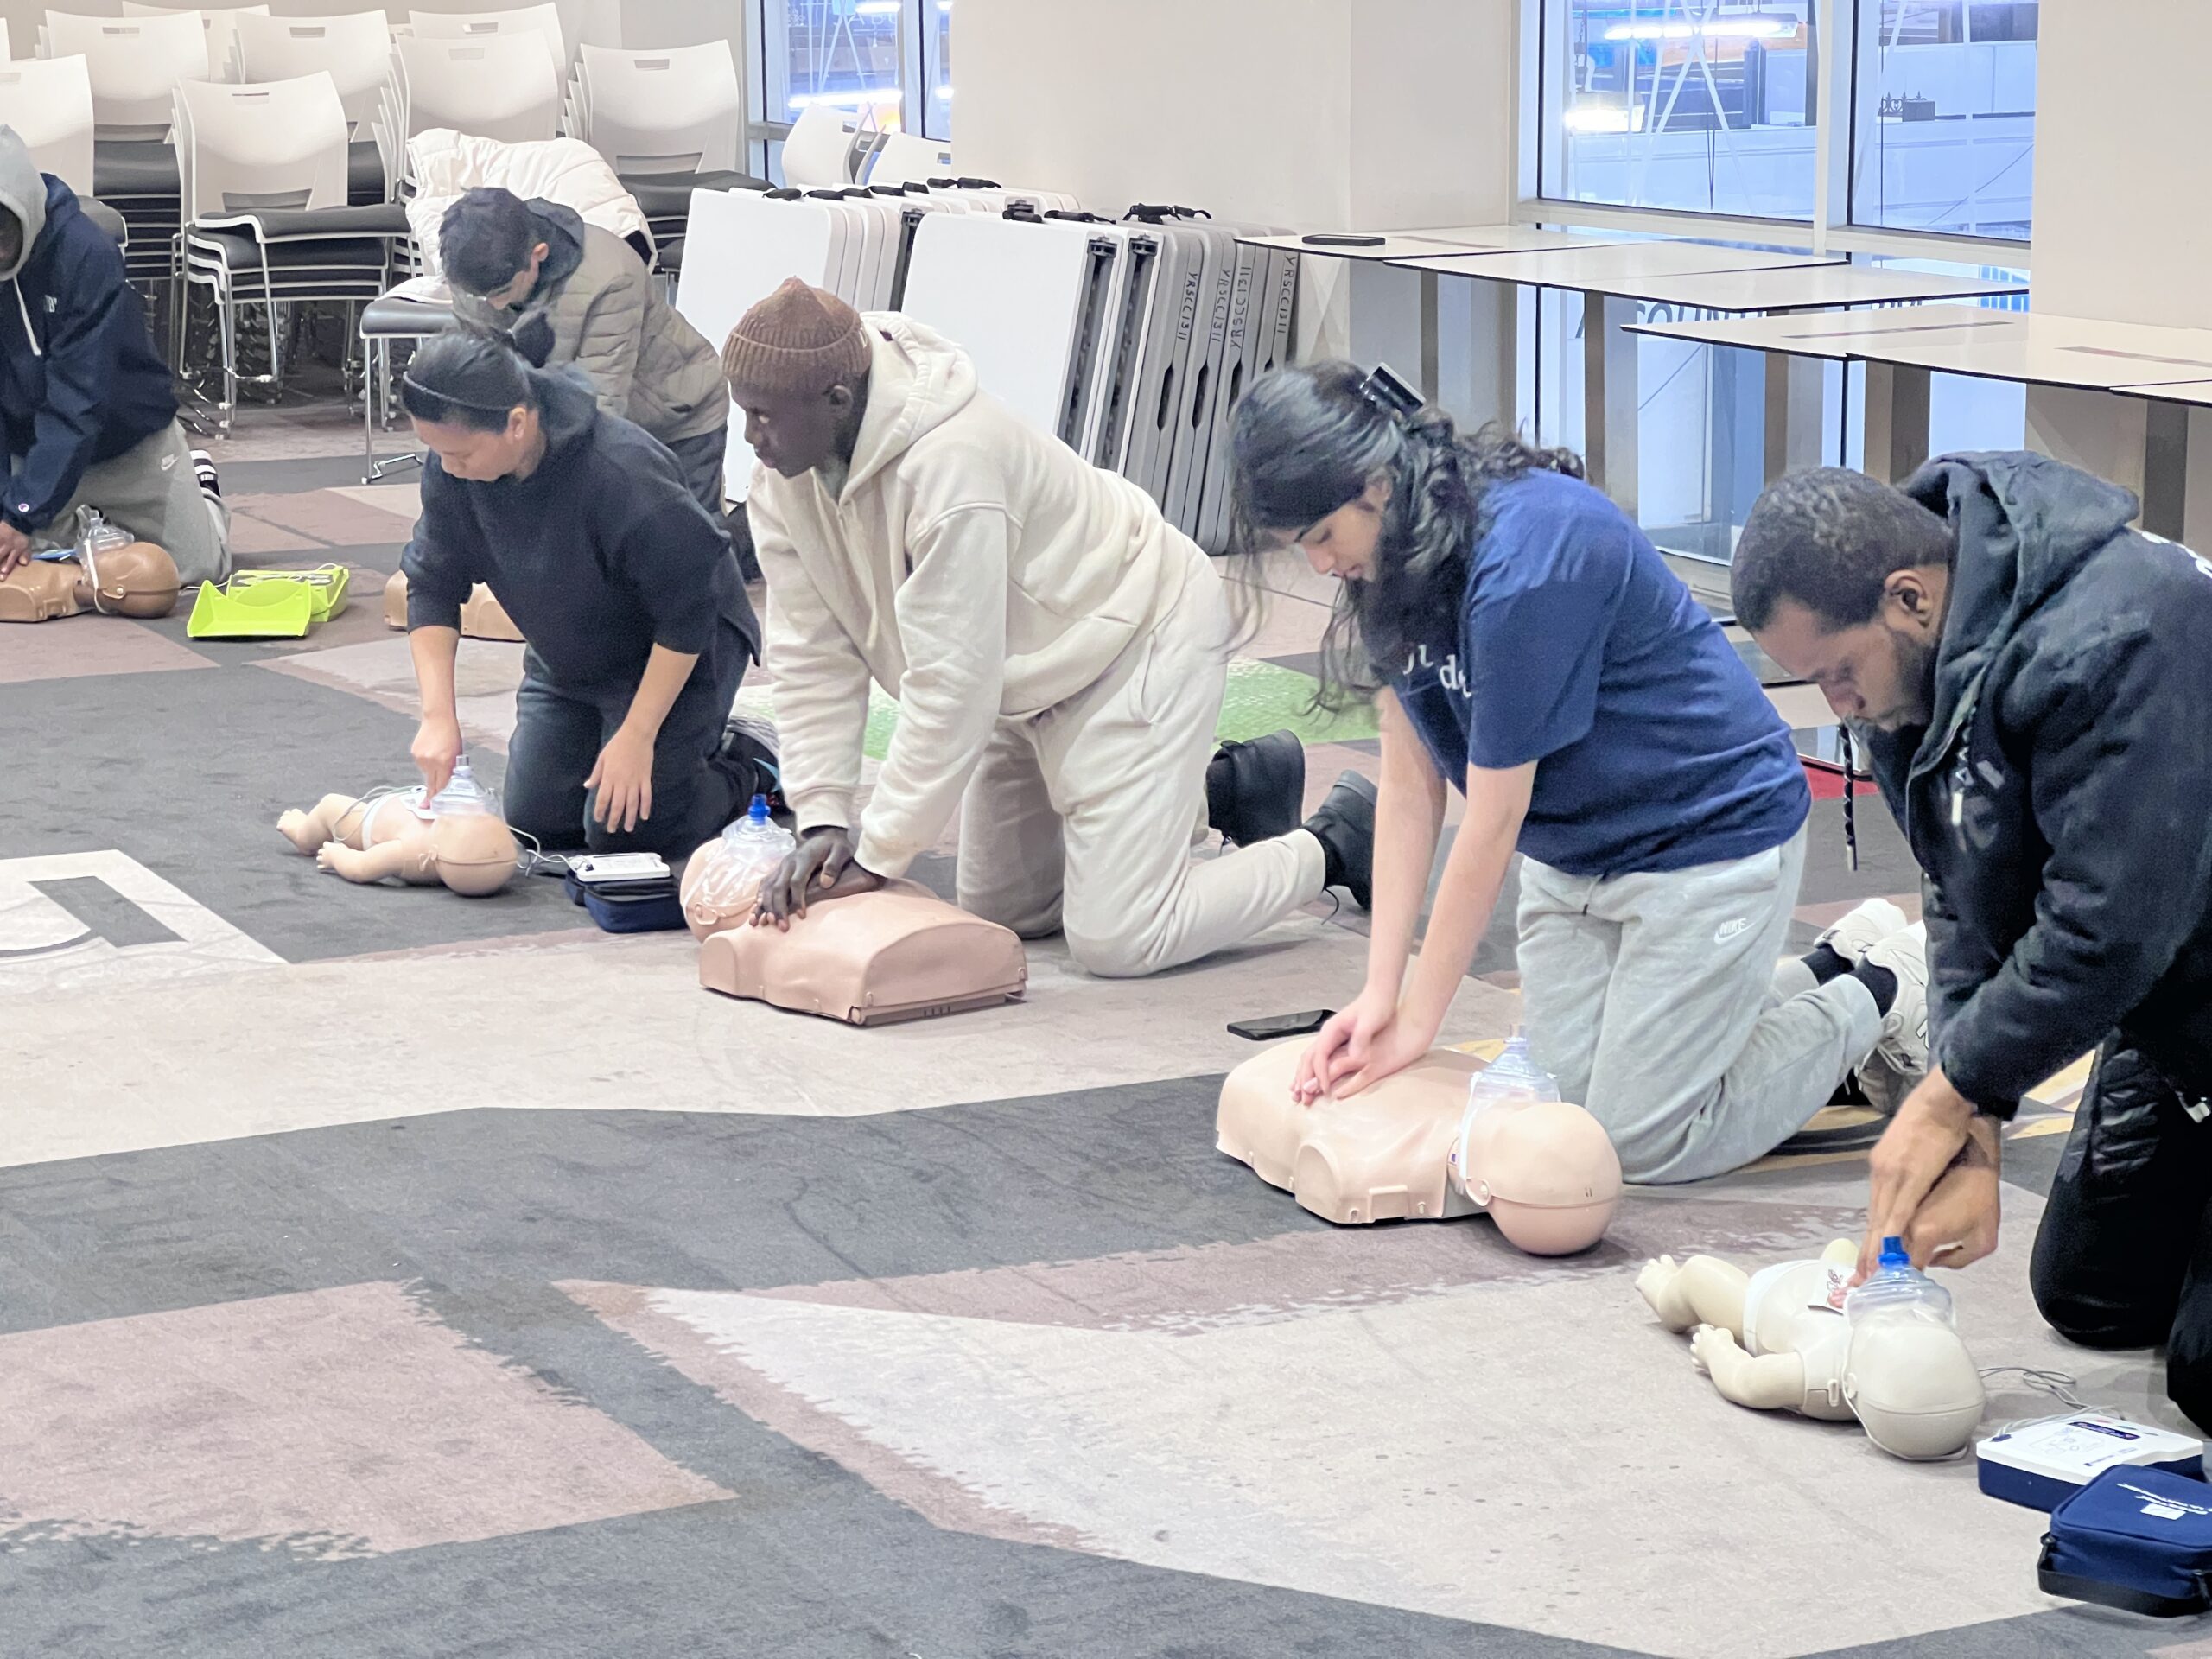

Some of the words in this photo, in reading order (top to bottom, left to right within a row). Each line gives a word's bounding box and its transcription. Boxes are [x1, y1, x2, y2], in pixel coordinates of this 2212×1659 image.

[1177, 272, 1198, 340] YRSCC1311
[1211, 269, 1231, 342] YRSCC1311
[1230, 266, 1251, 349] YRSCC1311
[1719, 918, 1746, 935] NIKE
